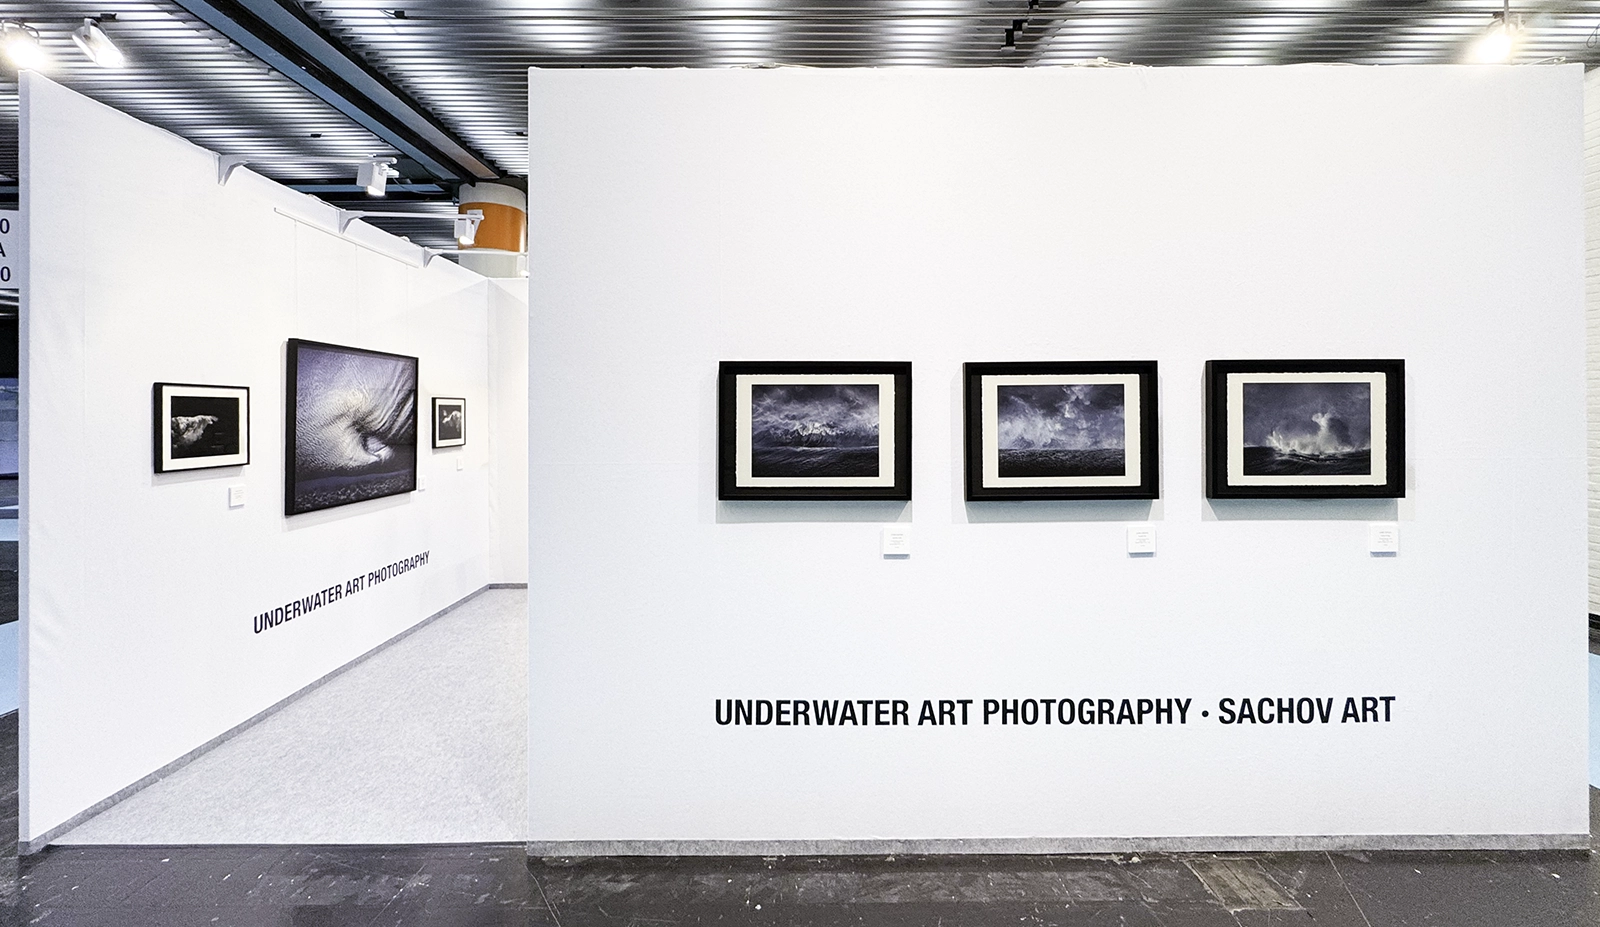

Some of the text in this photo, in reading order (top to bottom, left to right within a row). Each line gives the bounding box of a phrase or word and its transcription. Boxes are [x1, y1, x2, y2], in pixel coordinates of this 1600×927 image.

[252, 550, 431, 634] UNDERWATER ART PHOTOGRAPHY
[715, 699, 909, 726] UNDERWATER
[917, 699, 974, 726] ART
[983, 698, 1192, 726] PHOTOGRAPHY
[1218, 697, 1334, 725] SACHOV
[1341, 696, 1396, 724] ART
